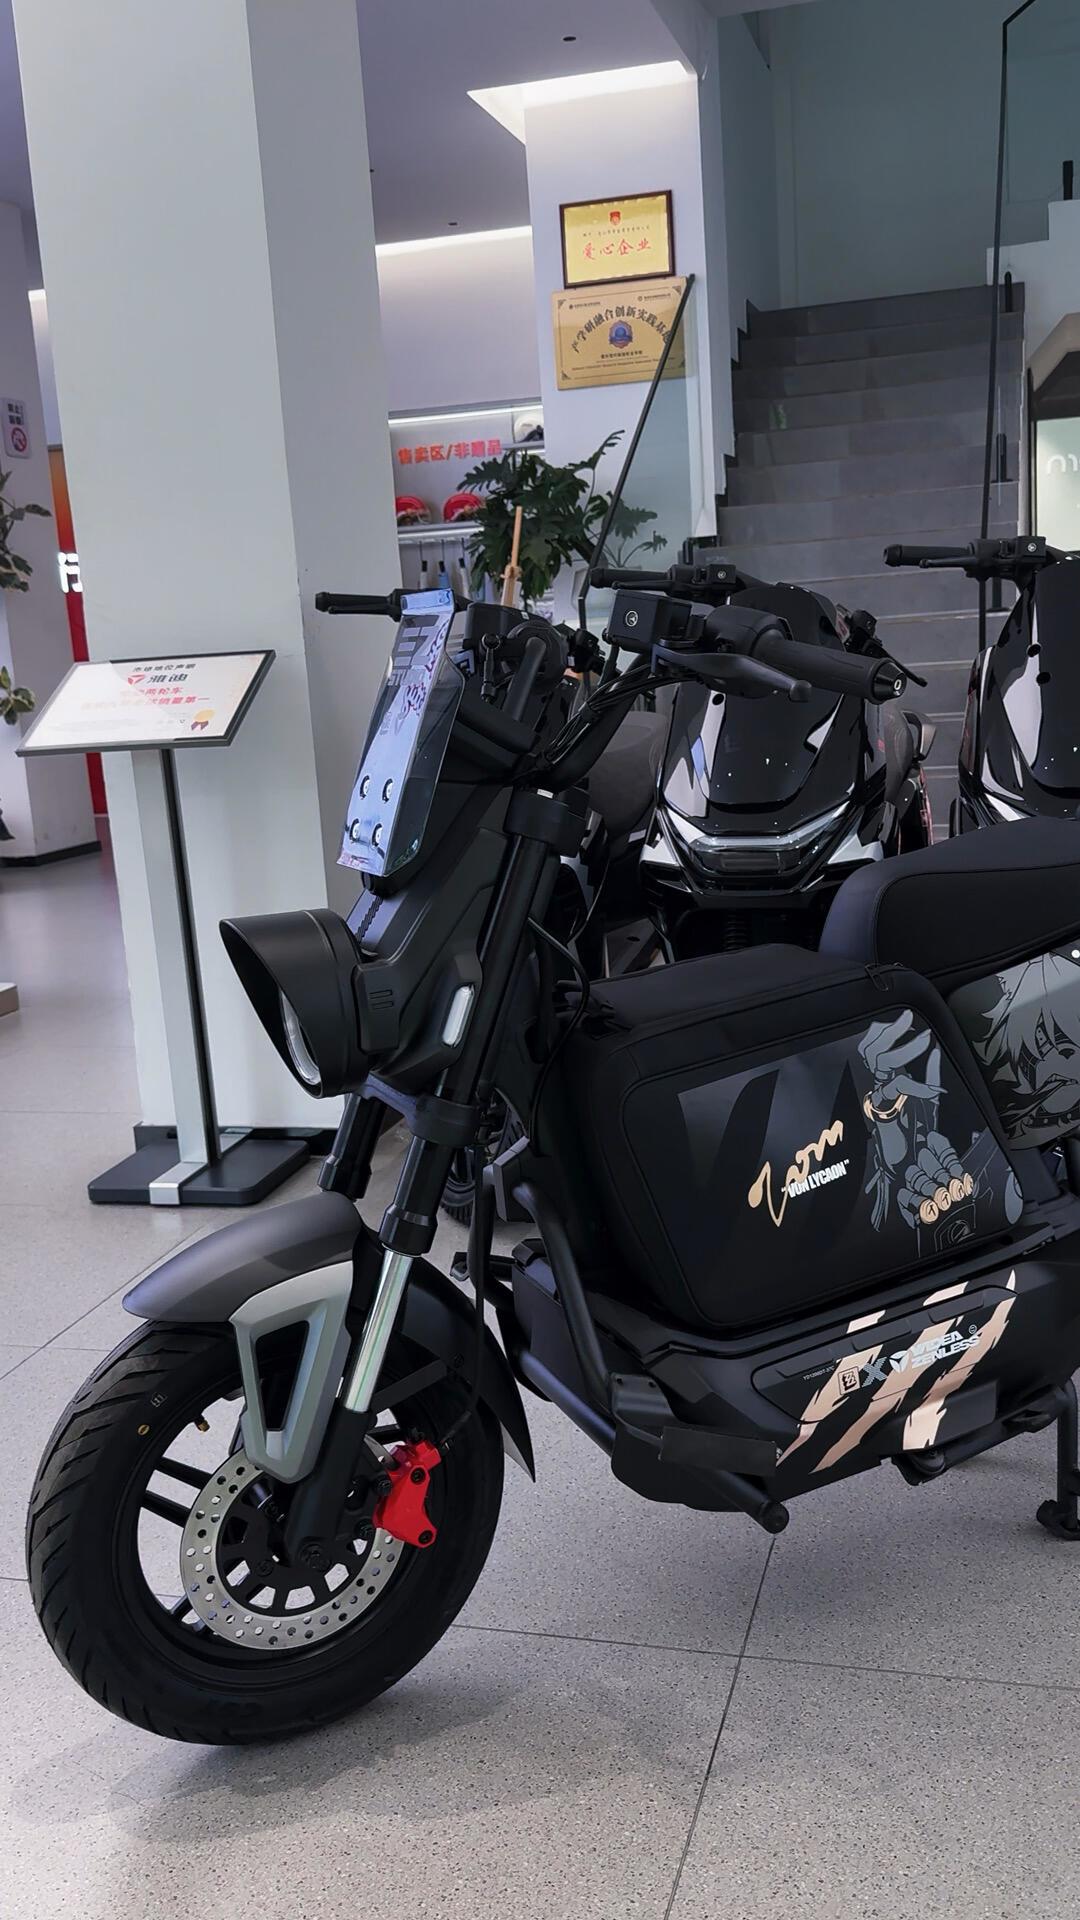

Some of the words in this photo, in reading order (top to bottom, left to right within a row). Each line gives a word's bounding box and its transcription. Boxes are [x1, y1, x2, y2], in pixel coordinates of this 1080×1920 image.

[583, 238, 651, 260] 爱心企业
[911, 1334, 982, 1369] ZENLESS
